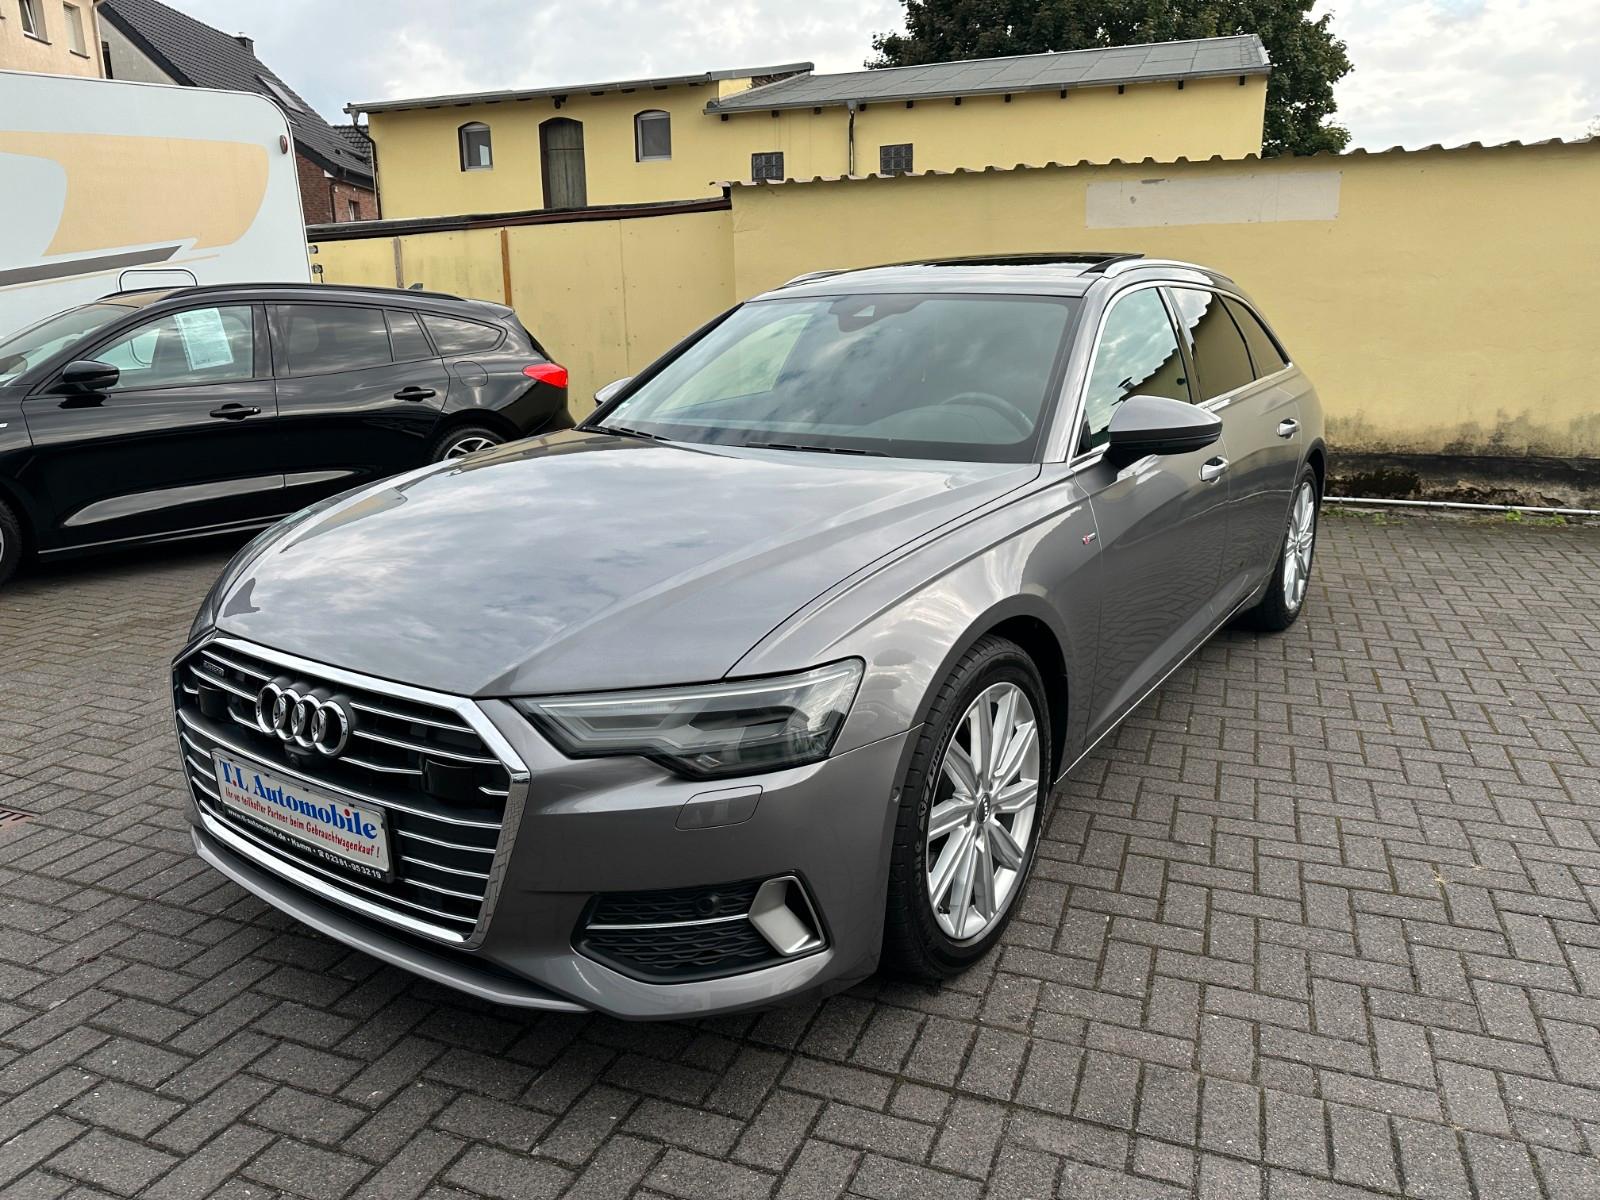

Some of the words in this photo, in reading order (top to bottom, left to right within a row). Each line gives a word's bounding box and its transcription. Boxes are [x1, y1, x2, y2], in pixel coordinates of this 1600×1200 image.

[253, 774, 377, 840] Automobile
[267, 805, 288, 823] Partner
[290, 815, 304, 830] beim
[306, 822, 375, 856] Gebrauchtwagenkauf
